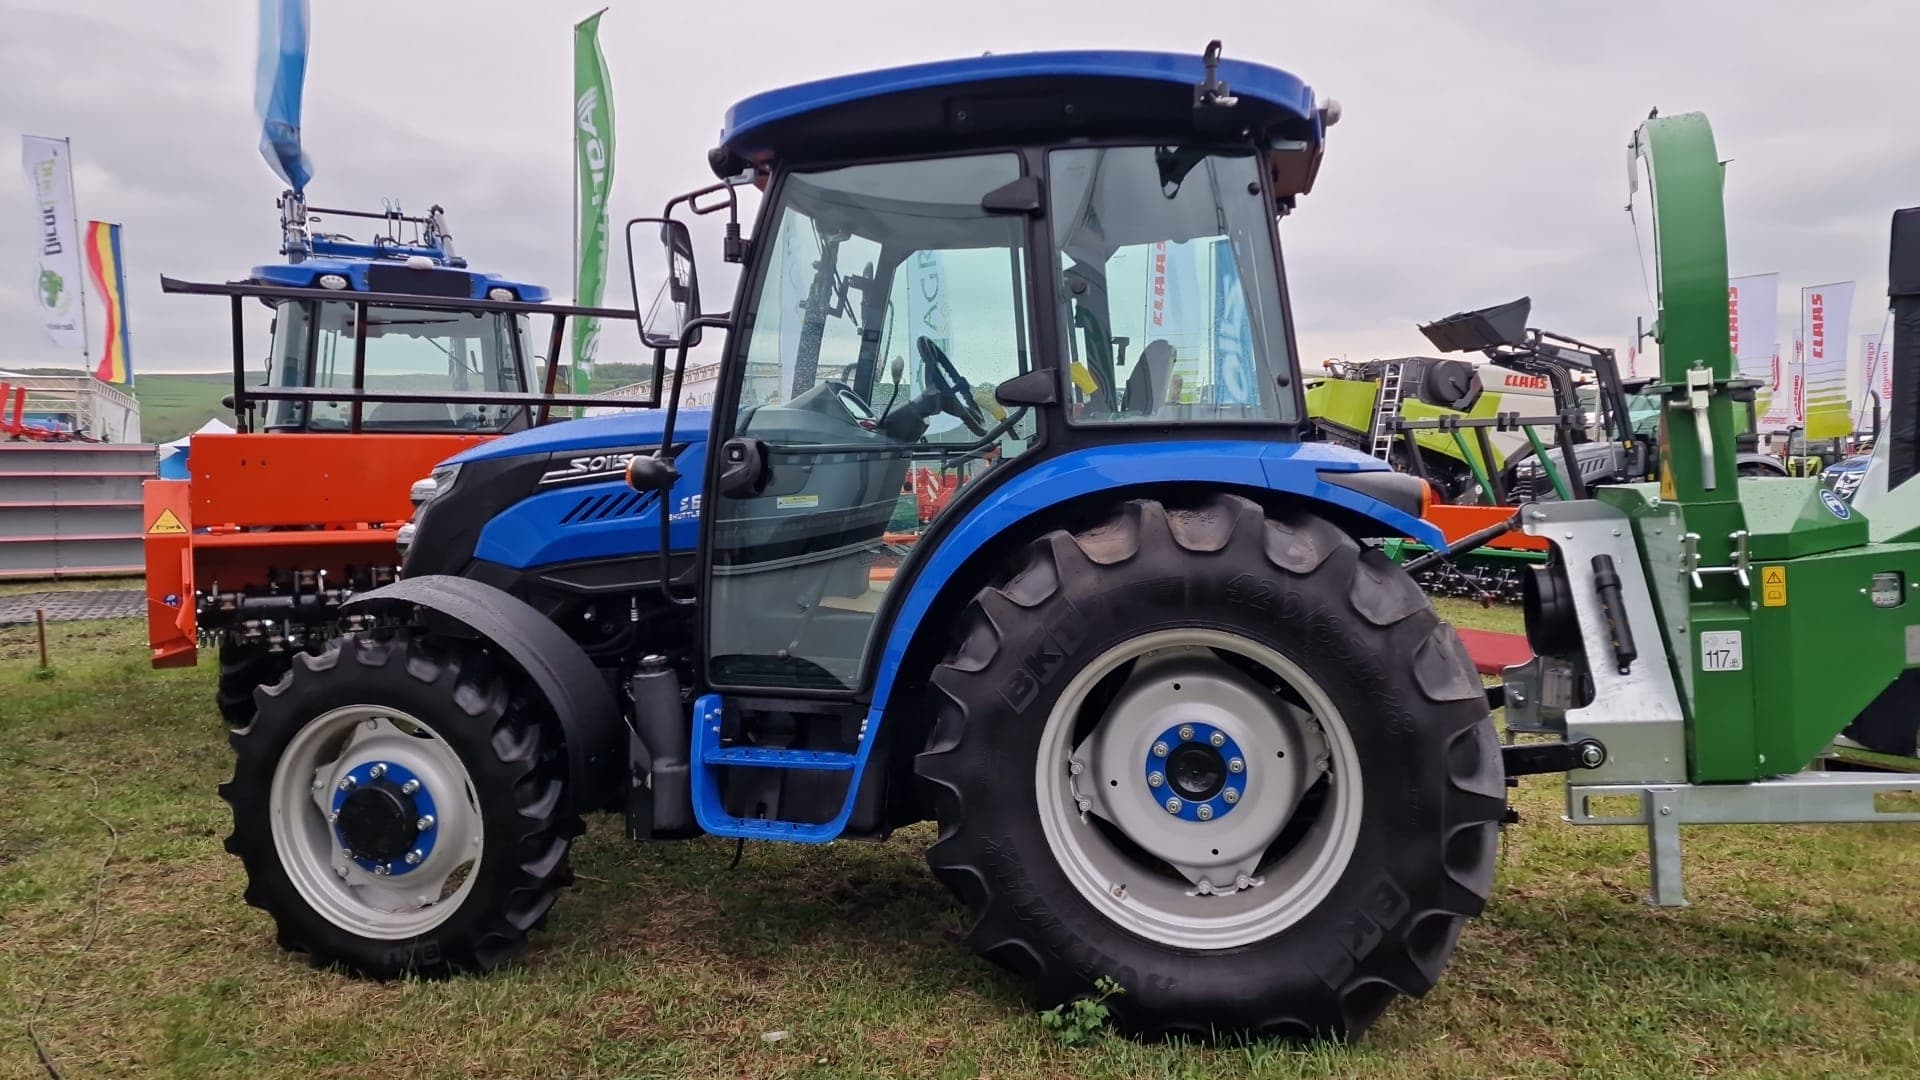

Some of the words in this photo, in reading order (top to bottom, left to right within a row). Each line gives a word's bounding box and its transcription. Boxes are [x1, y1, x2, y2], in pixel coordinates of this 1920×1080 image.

[1811, 293, 1824, 359] CLAAS
[1504, 374, 1548, 390] CLAAS
[1705, 649, 1730, 669] 117
